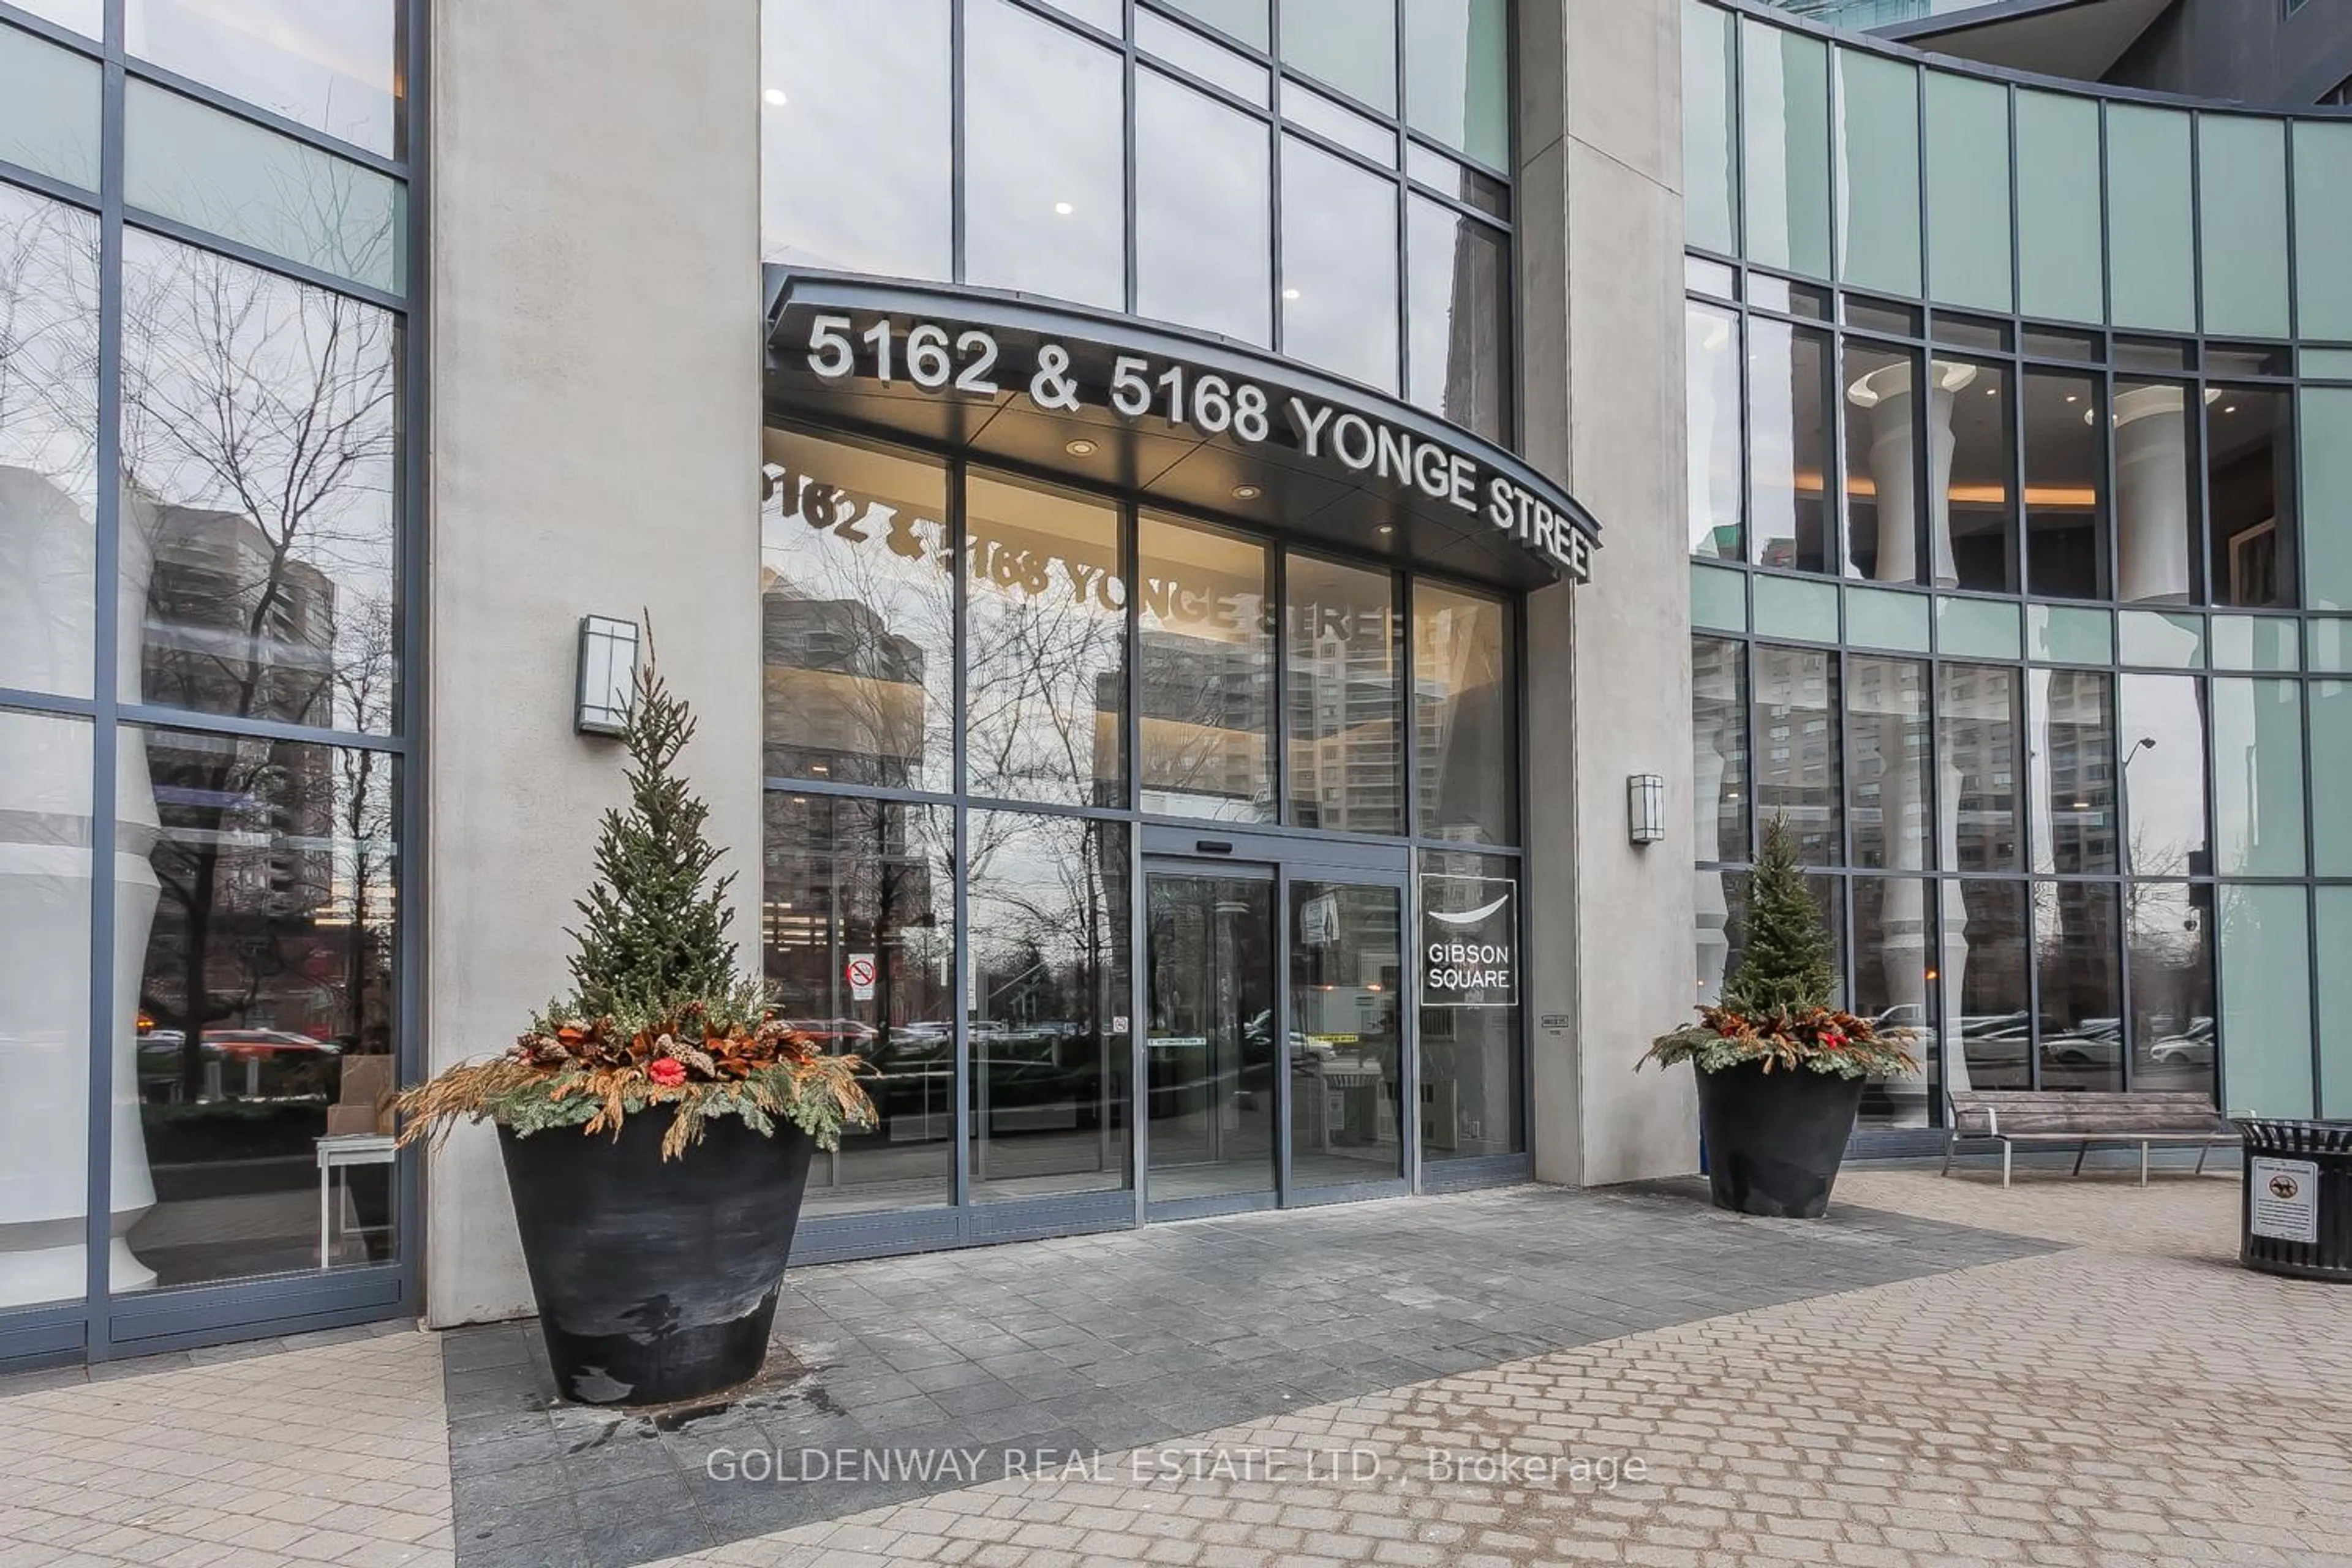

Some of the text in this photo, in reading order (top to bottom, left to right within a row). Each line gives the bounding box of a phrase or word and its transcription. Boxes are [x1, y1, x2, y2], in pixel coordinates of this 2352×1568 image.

[807, 315, 1593, 584] 5162 & 5168 YONGE STREET
[1428, 943, 1509, 963] GIBSON
[1429, 968, 1510, 990] SQUARE
